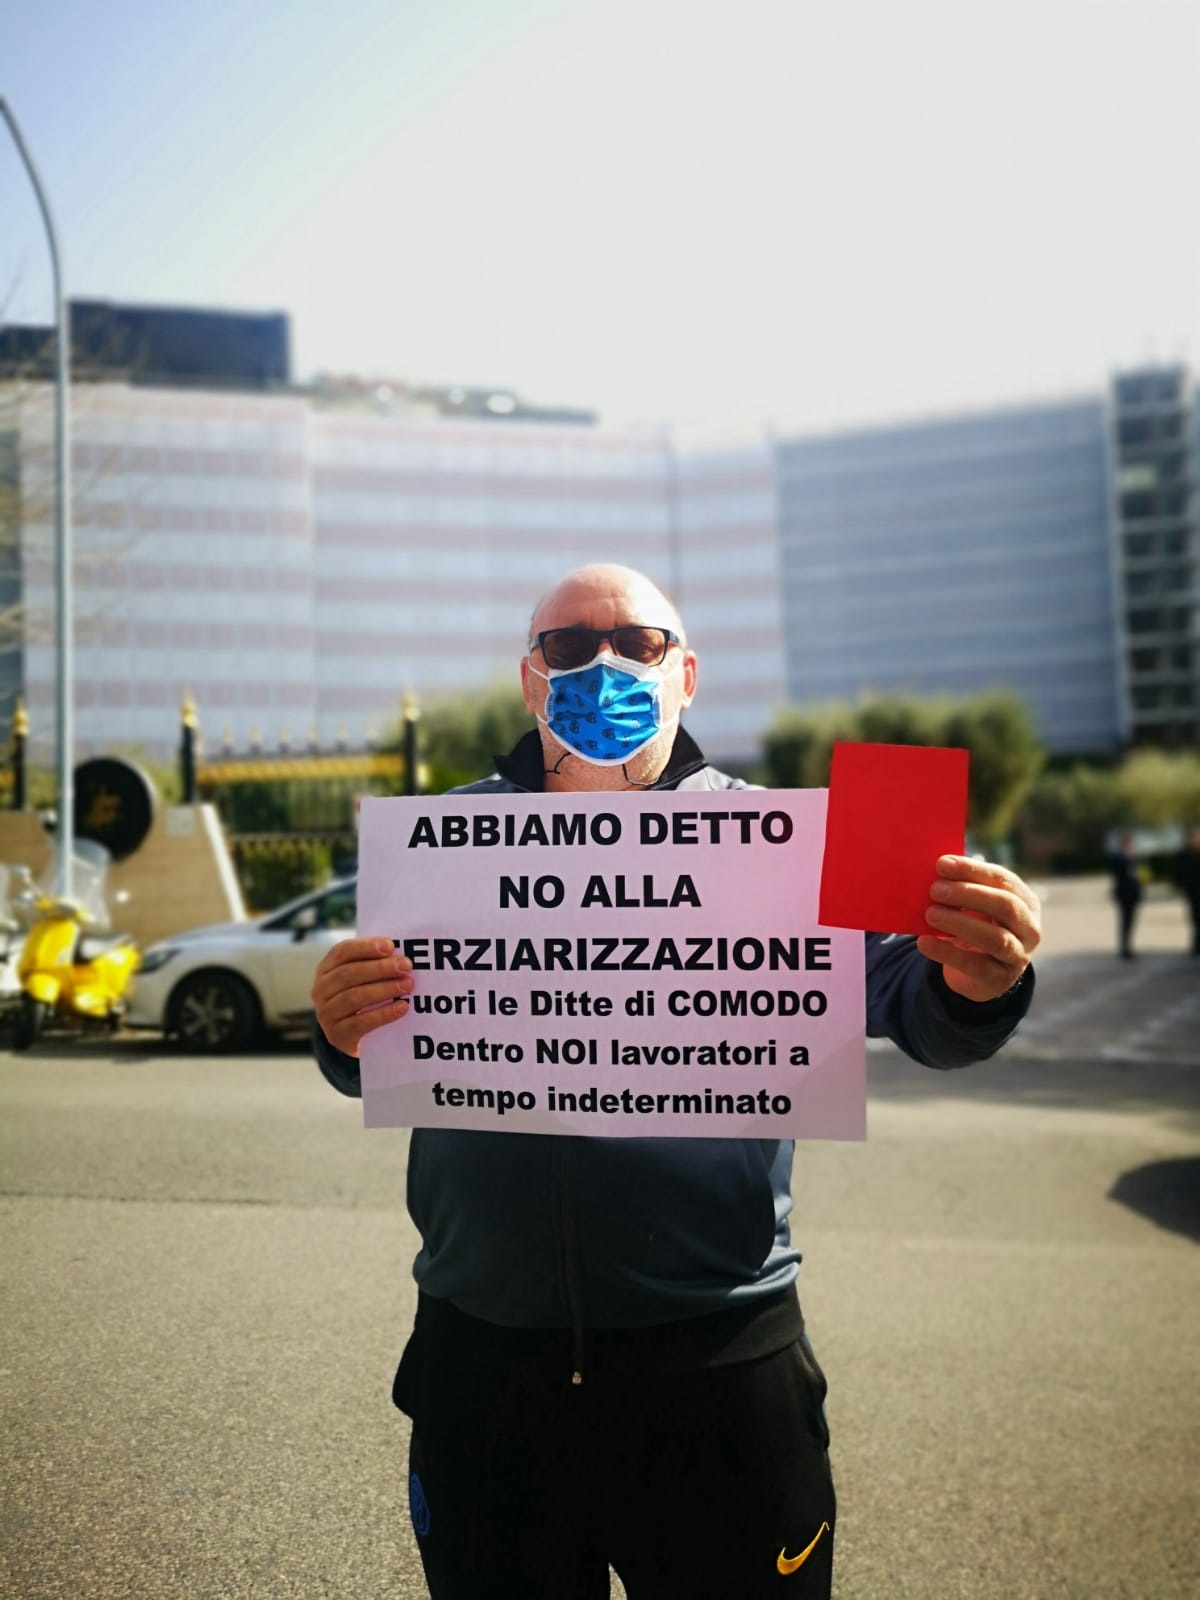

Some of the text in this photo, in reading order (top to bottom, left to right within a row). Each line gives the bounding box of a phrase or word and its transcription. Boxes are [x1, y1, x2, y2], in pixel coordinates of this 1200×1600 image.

[407, 811, 794, 849] ABBIAMO DETTO
[499, 874, 702, 909] NO ALLA
[392, 937, 832, 971] ERZIARIZZAZIONE
[488, 989, 519, 1016] le
[530, 990, 613, 1017] Ditte
[624, 990, 655, 1017] di
[667, 989, 828, 1017] COMODO
[412, 1034, 810, 1066] Dentro NOI lavoratori a
[431, 1081, 792, 1116] tempo indeterminato
